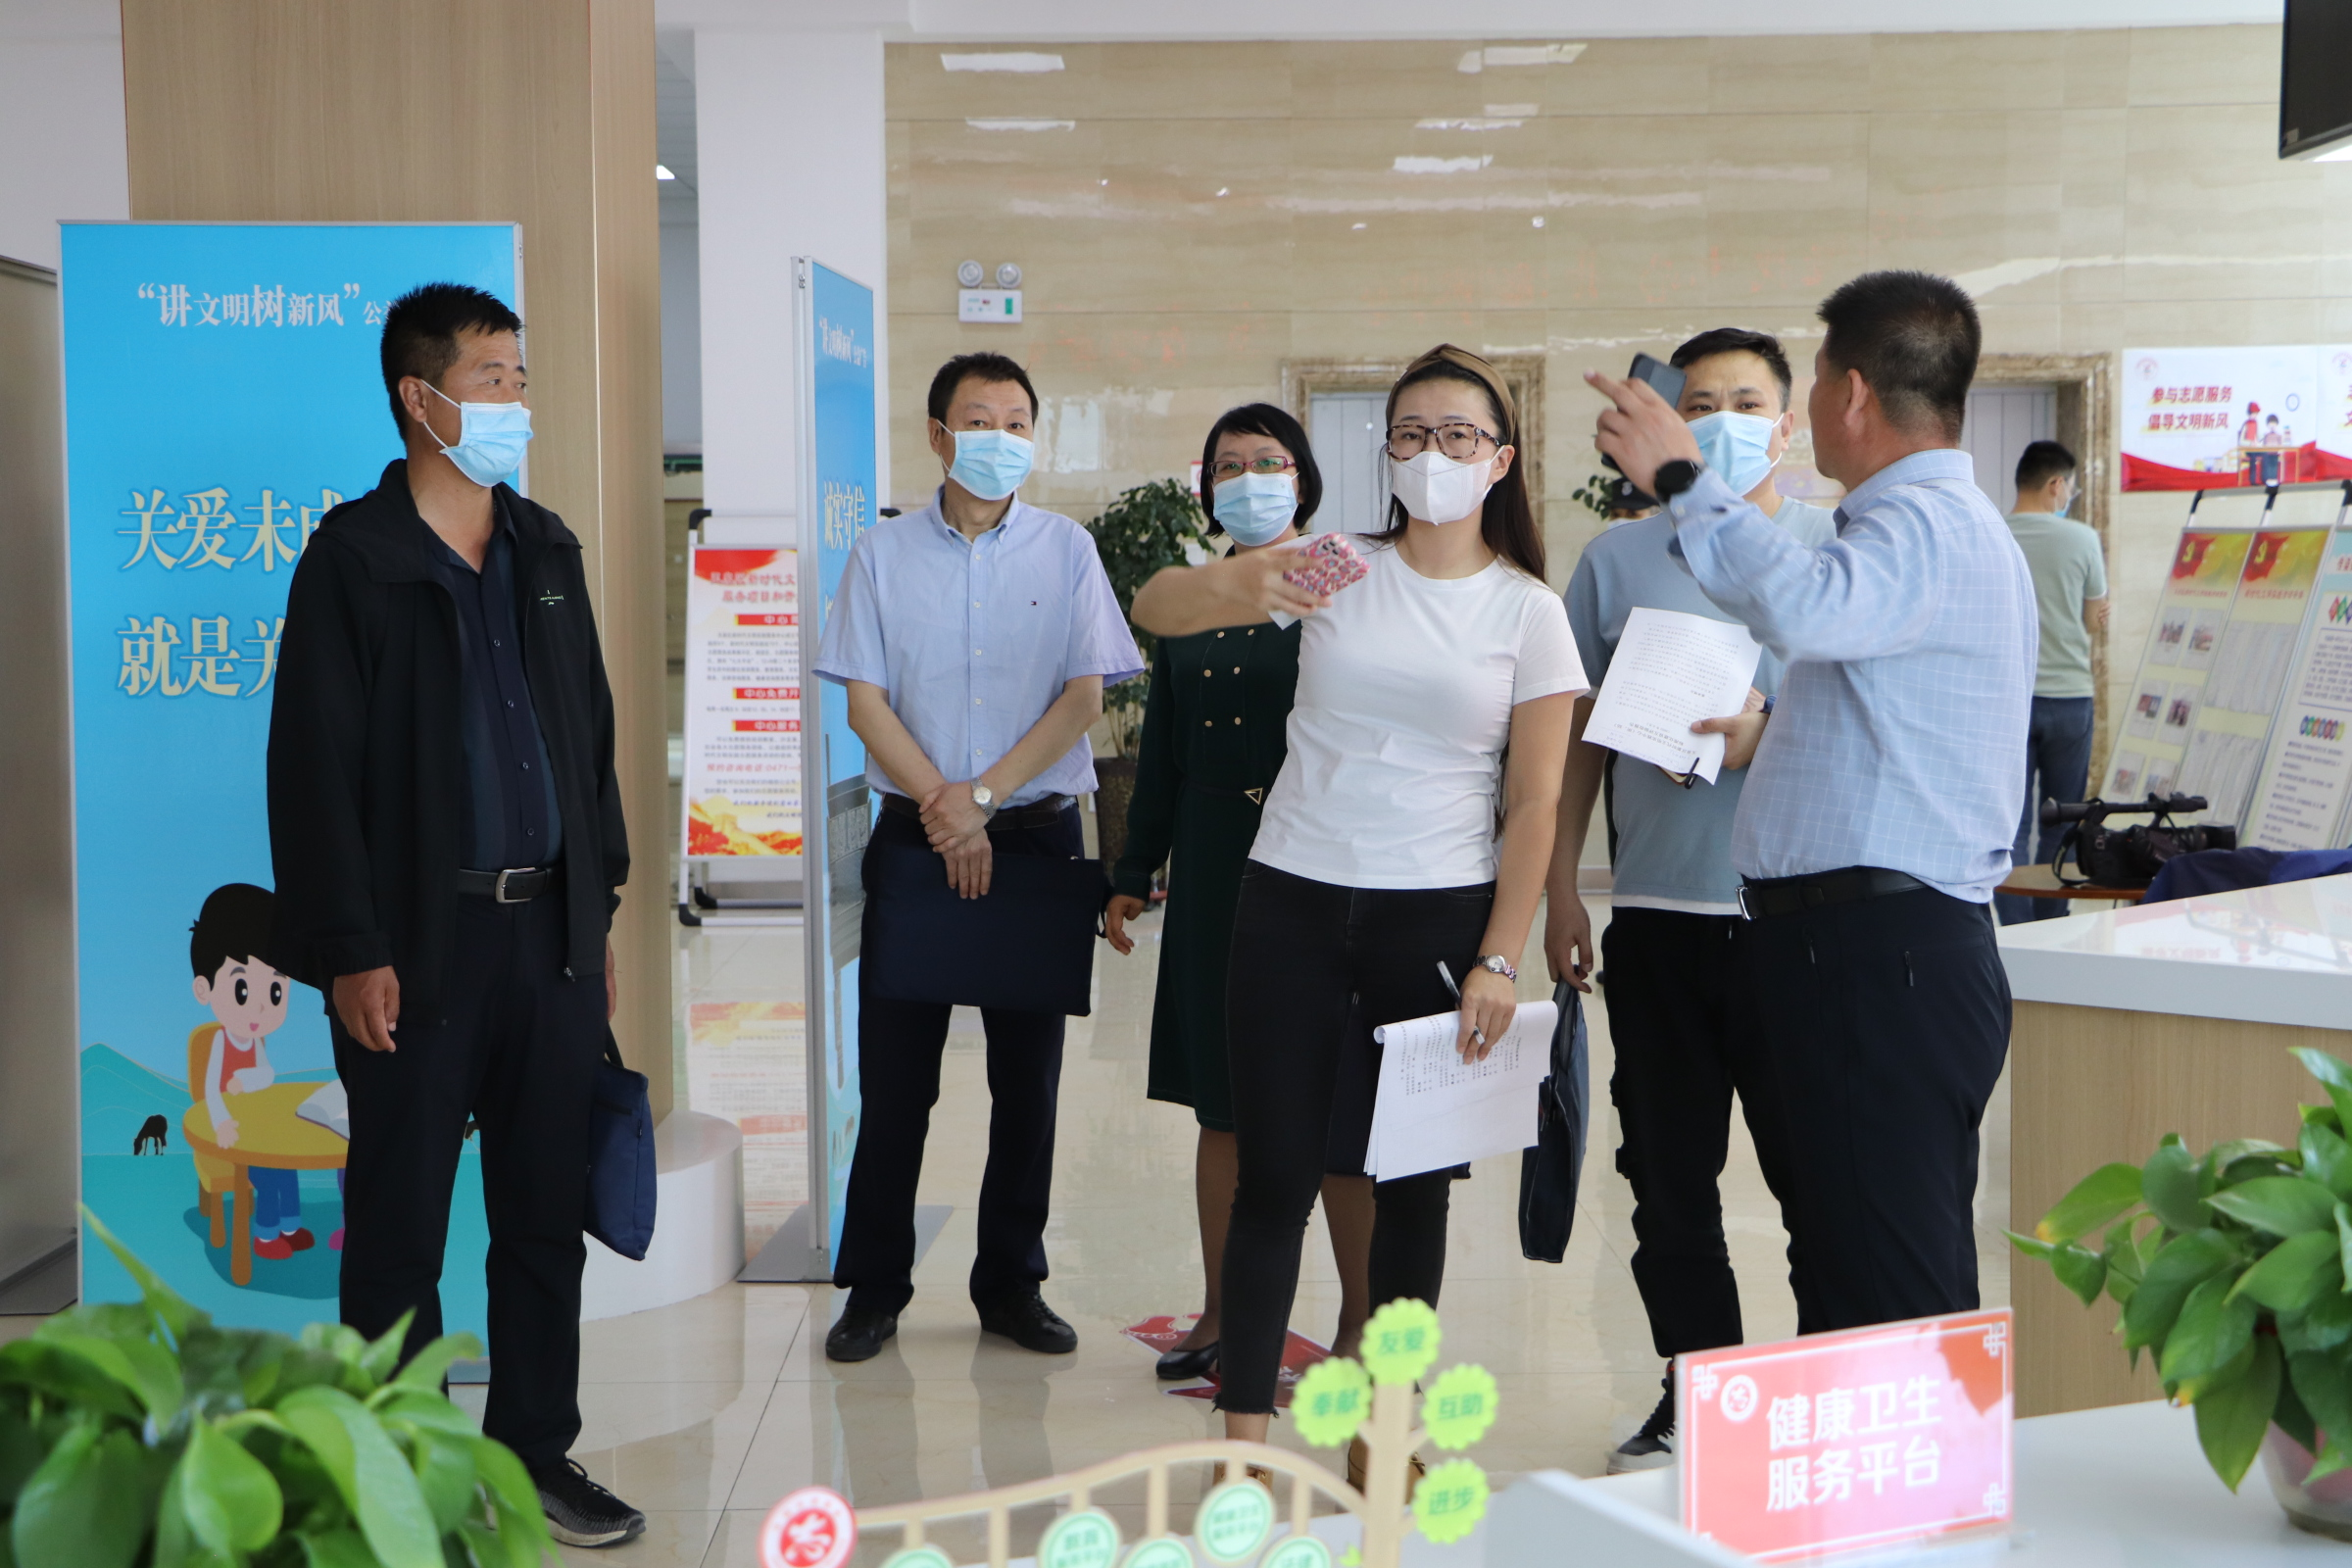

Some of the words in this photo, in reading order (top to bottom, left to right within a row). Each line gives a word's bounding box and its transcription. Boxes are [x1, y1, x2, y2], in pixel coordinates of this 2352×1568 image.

[2151, 386, 2232, 404] 参与志愿服务
[2147, 412, 2230, 431] 倡导文明新风
[1377, 1326, 1426, 1354] 友爱
[1312, 1388, 1360, 1416] 奉献
[1438, 1393, 1484, 1420] 互助
[1766, 1374, 1943, 1451] 健康卫生
[1766, 1435, 1942, 1512] 服务平台
[1428, 1487, 1476, 1515] 进步
